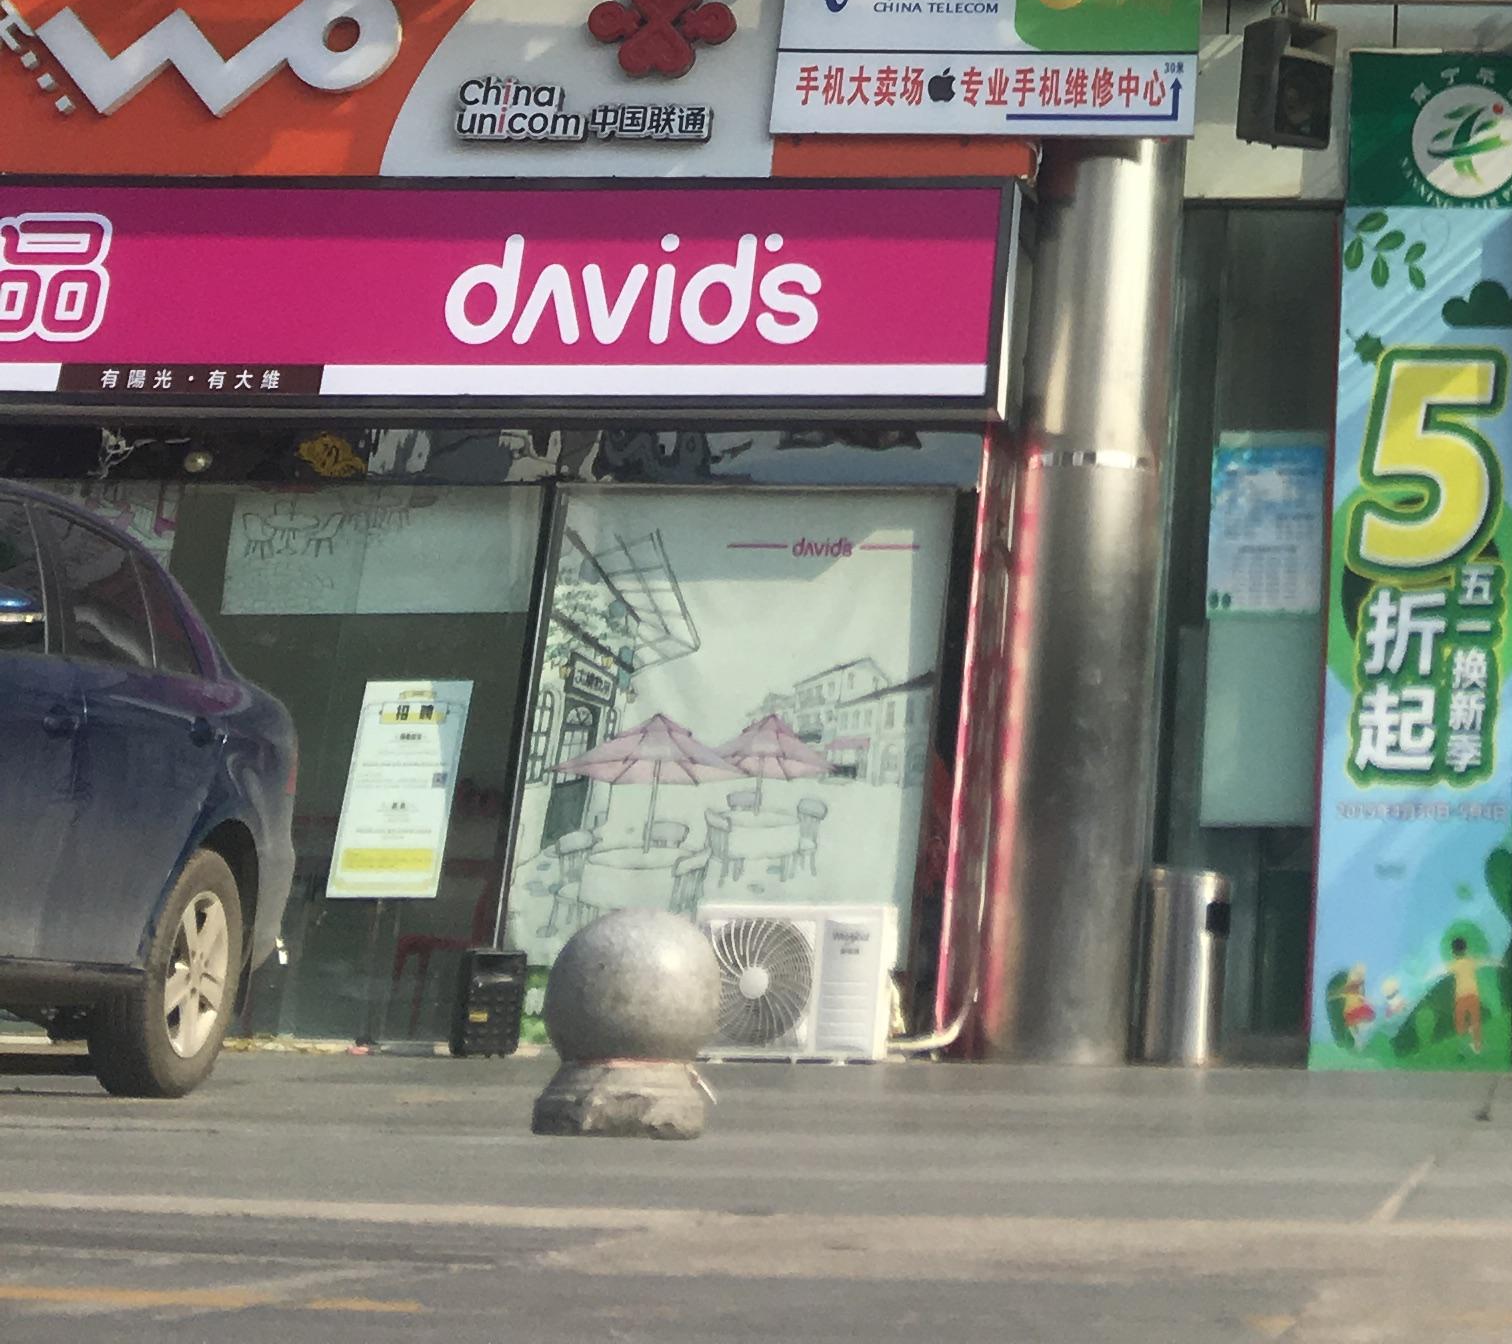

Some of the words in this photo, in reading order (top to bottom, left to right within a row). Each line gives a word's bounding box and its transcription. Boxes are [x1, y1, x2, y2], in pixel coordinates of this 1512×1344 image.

[874, 2, 922, 14] CHINA
[928, 2, 998, 15] TELECOM
[459, 76, 557, 107] China
[796, 65, 924, 107] 手机大卖场
[961, 66, 1167, 109] 专业手机维修中心
[457, 107, 582, 136] unicom
[590, 105, 706, 135] 中国联通
[1352, 352, 1503, 575] 5
[1355, 588, 1447, 772] 折起
